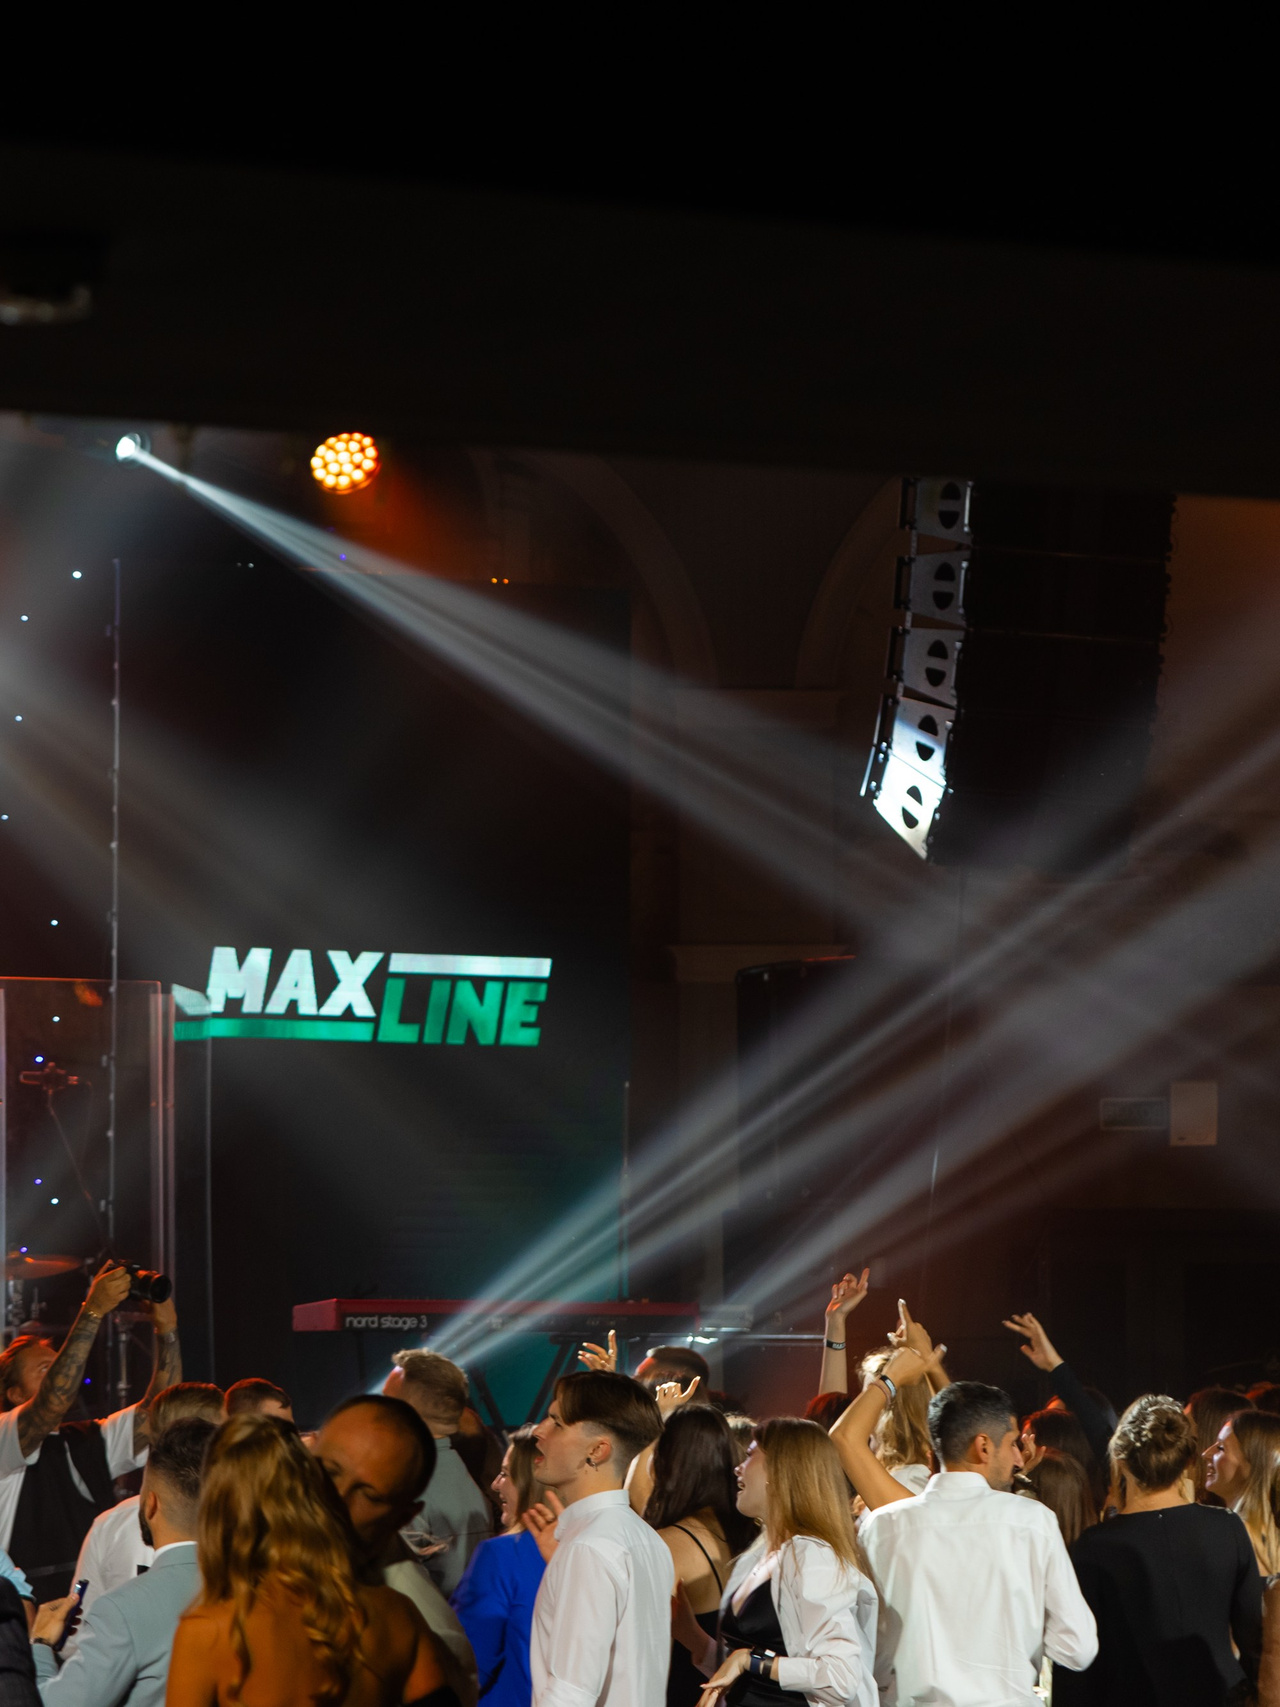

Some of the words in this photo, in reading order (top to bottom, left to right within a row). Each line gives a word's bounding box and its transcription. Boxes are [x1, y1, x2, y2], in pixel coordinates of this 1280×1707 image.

[345, 1315, 378, 1328] nord
[380, 1315, 418, 1330] stage
[419, 1315, 428, 1328] 3
